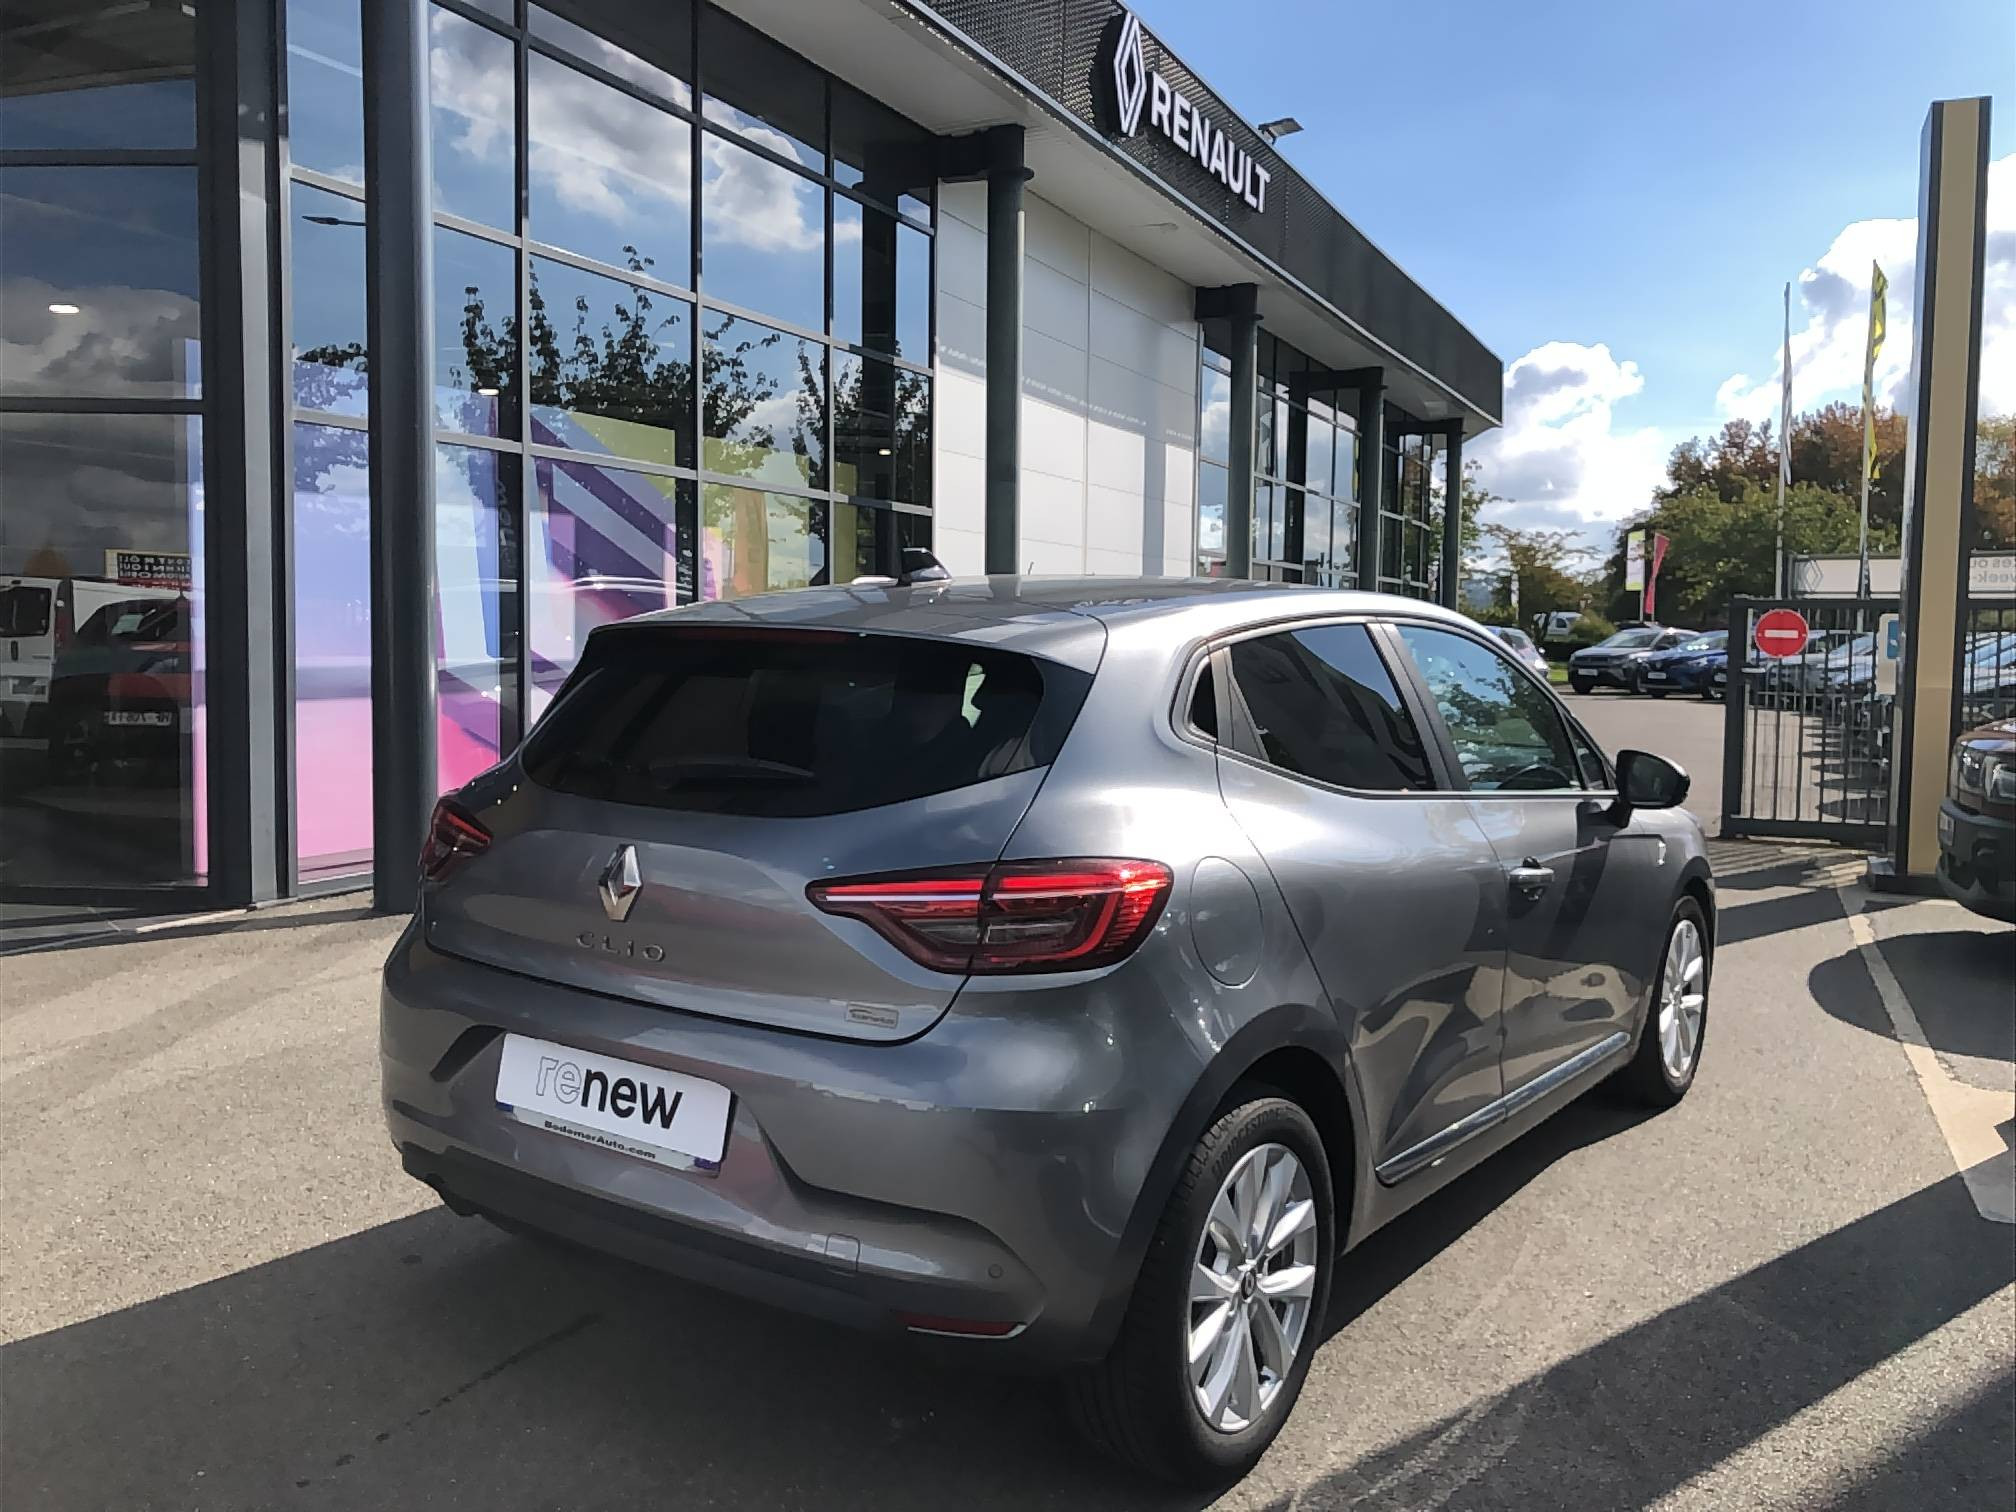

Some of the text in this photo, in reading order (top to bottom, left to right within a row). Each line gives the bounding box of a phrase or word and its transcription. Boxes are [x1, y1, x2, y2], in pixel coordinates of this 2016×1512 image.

[1151, 70, 1271, 214] RENAULT
[575, 931, 665, 962] CLIO
[536, 1055, 683, 1130] renew
[544, 1119, 656, 1160] BodemerAuto.com
